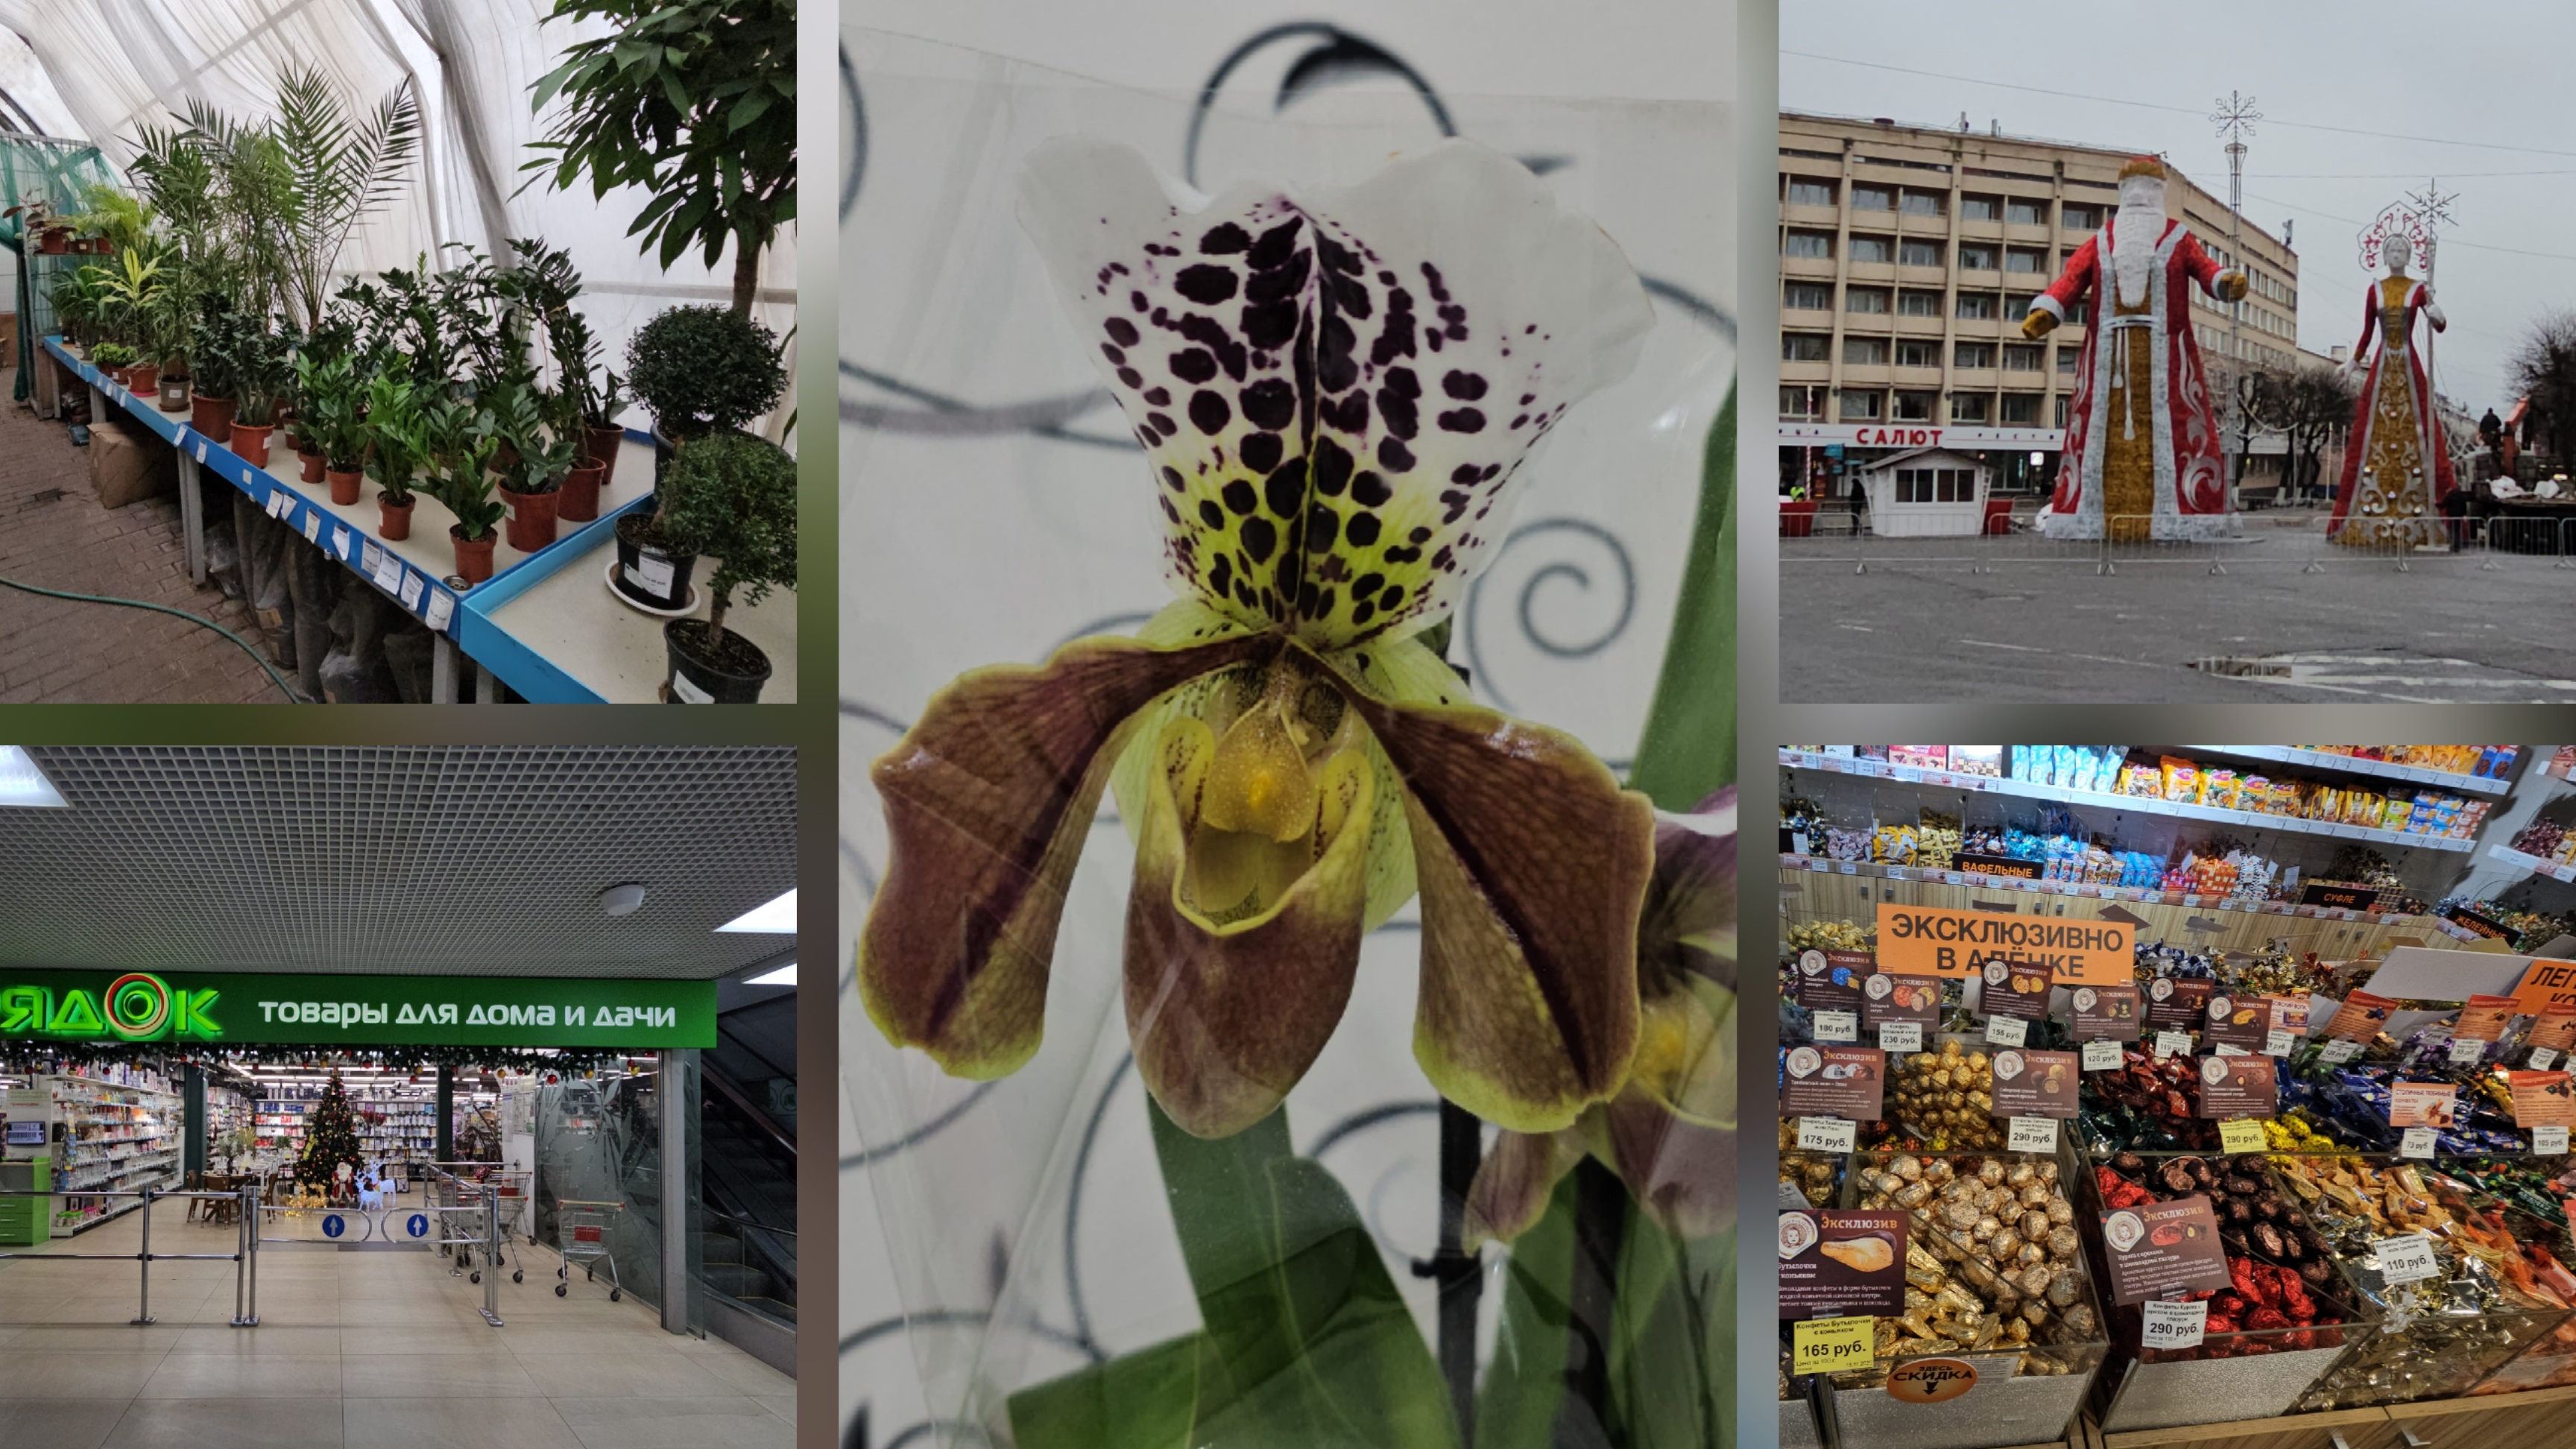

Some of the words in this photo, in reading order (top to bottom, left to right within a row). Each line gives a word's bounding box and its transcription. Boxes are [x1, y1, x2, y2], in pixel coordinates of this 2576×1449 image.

[1856, 429, 1942, 446] САЛЮТ
[1963, 862, 2033, 877] ВАФЕЛЬНЫЕ
[2323, 893, 2355, 904] СУФЛЕ
[1891, 913, 2123, 952] ЭКСКЛЮЗИВНО
[1827, 953, 1870, 964] Эксклюзив
[1936, 947, 1957, 970] В
[2010, 965, 2048, 976] Эксклюзив
[1892, 977, 1935, 986] Эксклюзив
[2174, 980, 2210, 990] Эксклюзив
[0, 973, 224, 1037] ЯДОК
[2232, 1000, 2267, 1008] Эксклюзив
[258, 1001, 388, 1029] товары
[395, 1003, 458, 1025] для
[465, 1003, 556, 1027] дома
[564, 1006, 586, 1026] и
[593, 1006, 676, 1028] дачи
[1836, 1025, 1853, 1034] руб.
[1900, 1037, 1918, 1045] руб.
[2006, 1032, 2021, 1040] руб.
[1823, 1050, 1877, 1062] Эксклюзив
[2025, 1054, 2072, 1064] Эксклюзив
[2102, 1054, 2119, 1062] руб.
[2229, 1059, 2269, 1067] Эксклюзив
[1804, 1134, 1822, 1144] 175
[1825, 1137, 1848, 1148] руб.
[2013, 1132, 2030, 1141] 290
[2033, 1134, 2053, 1144] руб.
[2226, 1135, 2241, 1143] 290
[2243, 1134, 2261, 1143] руб.
[2144, 1205, 2205, 1223] Эксклюзив
[1821, 1215, 1898, 1229] Эксклюзив
[2387, 1258, 2405, 1270] 110
[2407, 1254, 2430, 1269] руб.
[1831, 1319, 1871, 1327] Бутылочки
[2150, 1322, 2173, 1334] 290
[2176, 1322, 2199, 1336] руб.
[1802, 1344, 1829, 1357] 165
[1834, 1339, 1866, 1357] руб.
[1893, 1370, 1973, 1381] СКИДКА
